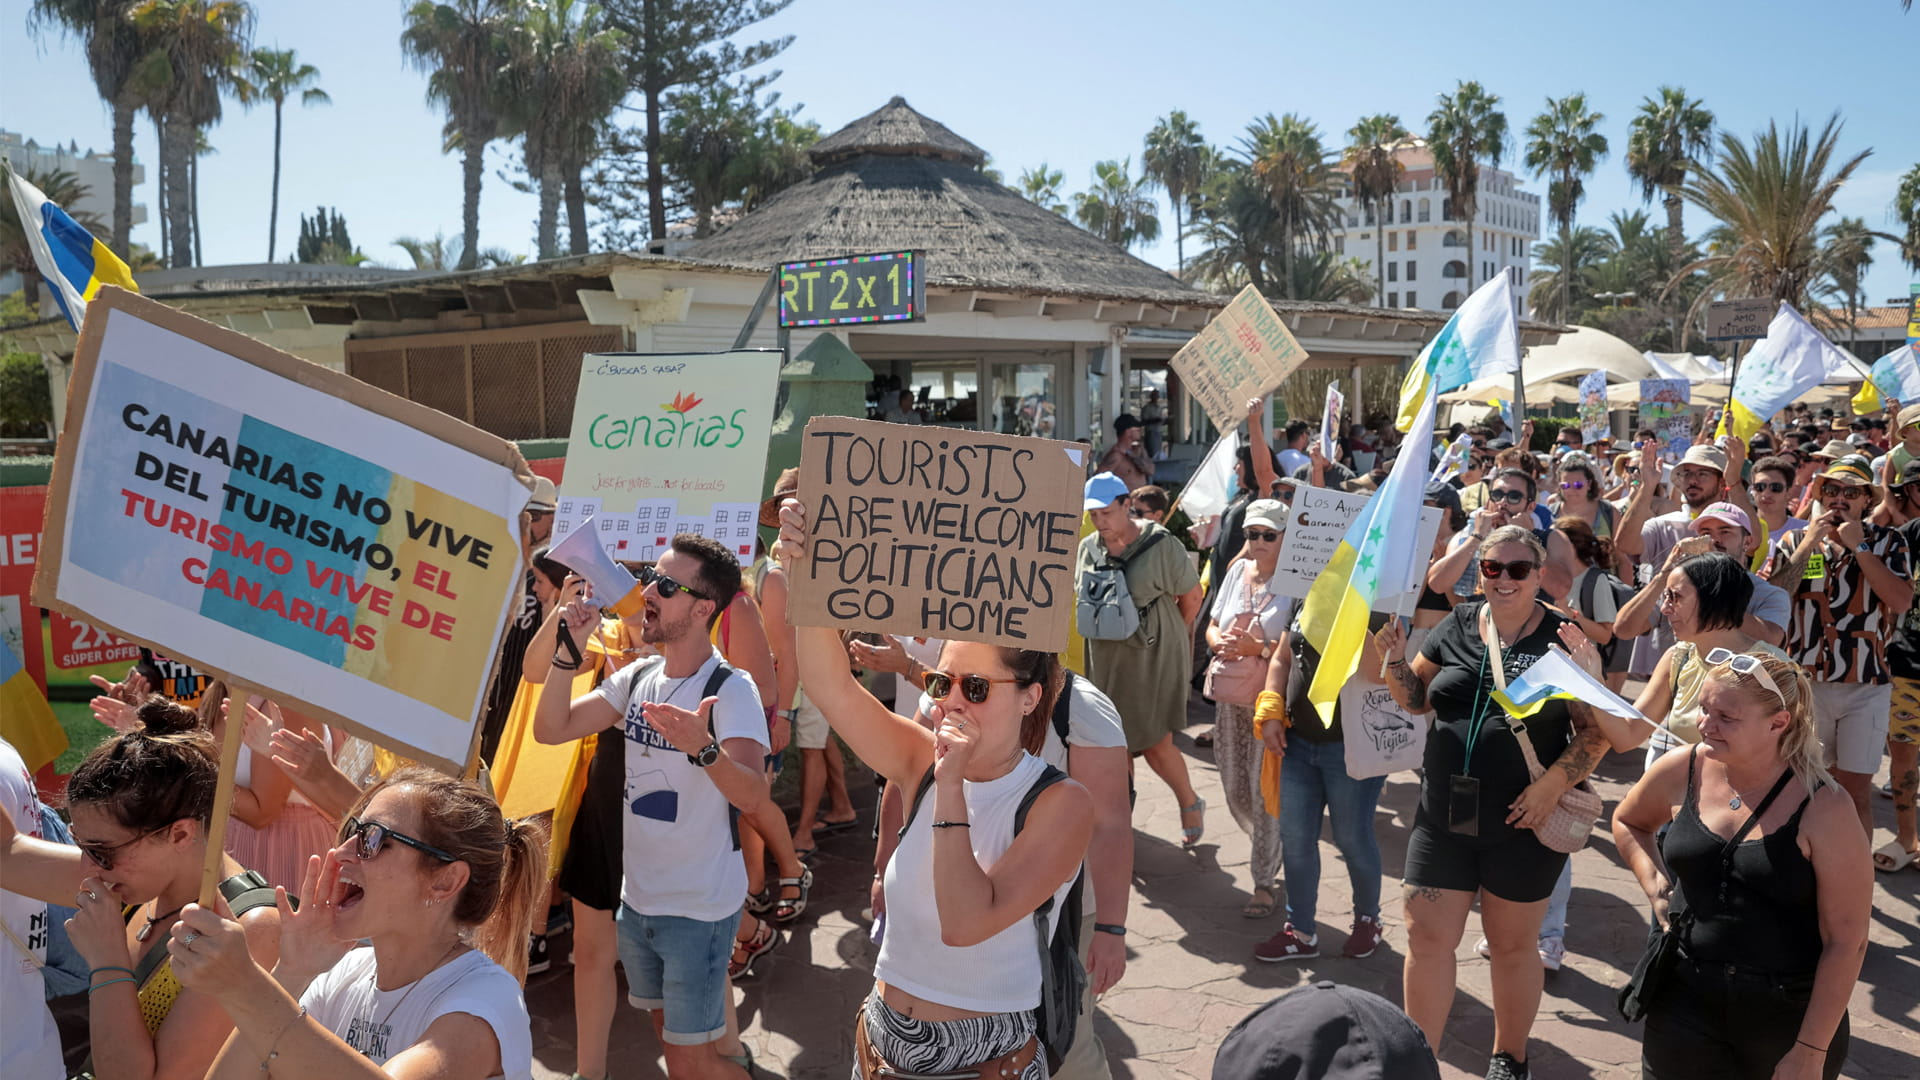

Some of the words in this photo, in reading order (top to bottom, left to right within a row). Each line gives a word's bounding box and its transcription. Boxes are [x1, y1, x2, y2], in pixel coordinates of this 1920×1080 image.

[122, 403, 325, 500] CANARIAS
[333, 483, 391, 525] NO
[405, 509, 493, 570] VIVE
[135, 451, 208, 502] DEL
[222, 483, 402, 582] TURISMO,
[412, 560, 457, 600] EL
[811, 494, 894, 539] ARE
[902, 498, 1077, 555] WELCOME
[121, 488, 294, 575] TURISMO
[306, 559, 394, 617] VIVE
[401, 599, 456, 641] DE
[182, 557, 378, 651] CANARIAS
[70, 620, 128, 650] 2X
[827, 588, 894, 620] GO
[921, 597, 1029, 639] HOME
